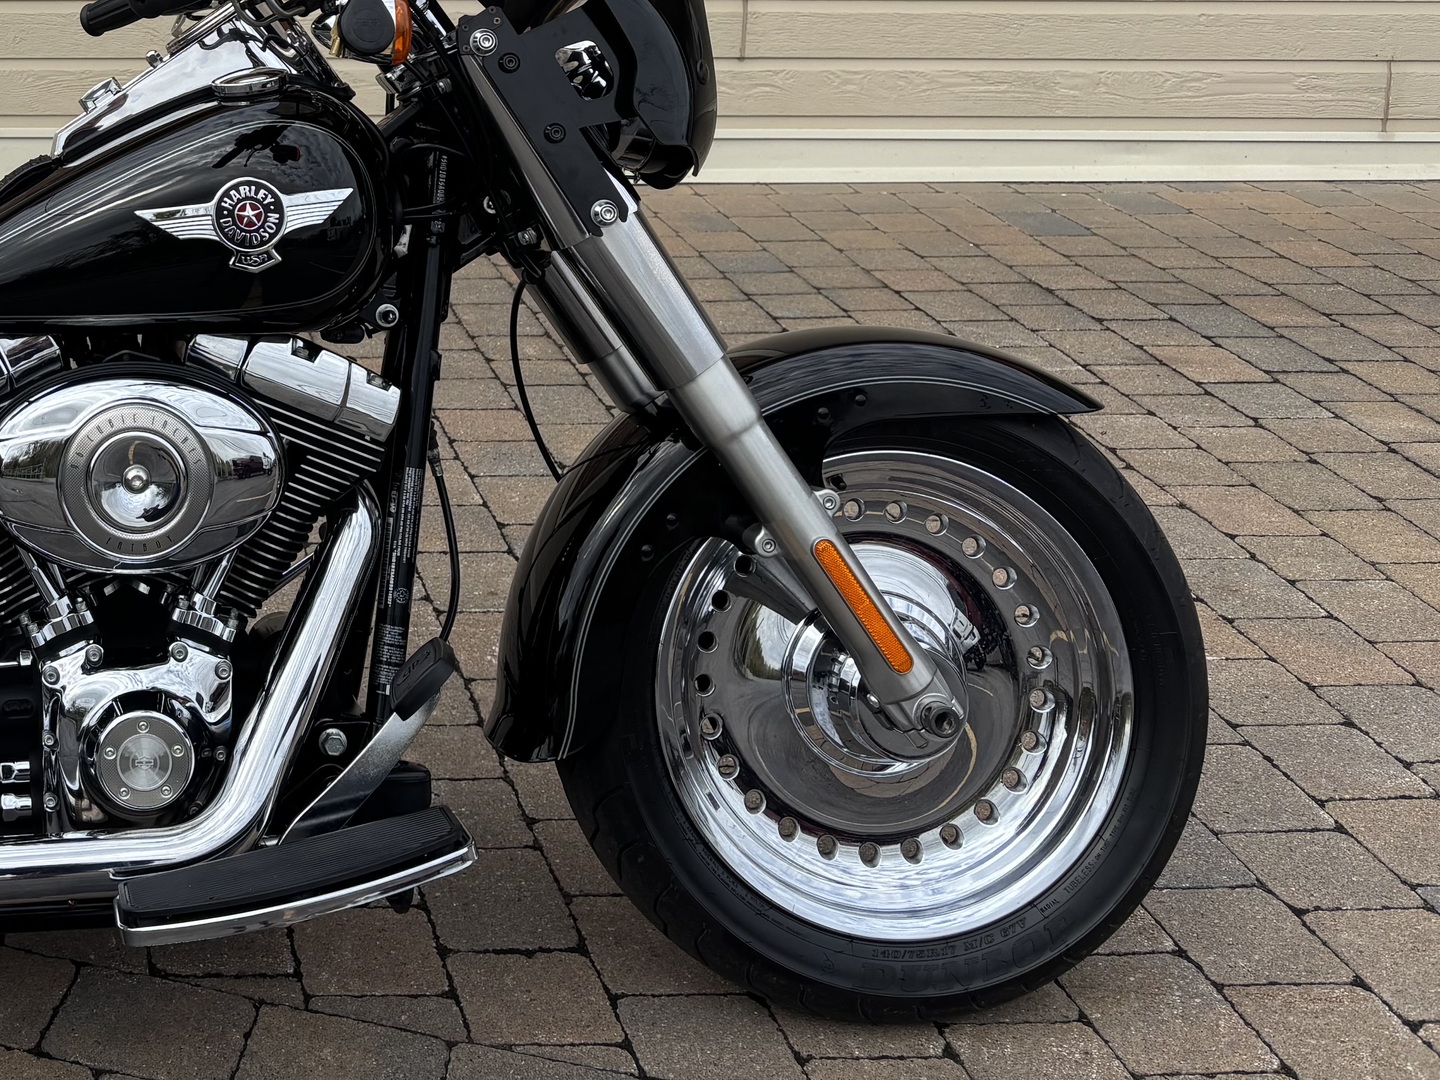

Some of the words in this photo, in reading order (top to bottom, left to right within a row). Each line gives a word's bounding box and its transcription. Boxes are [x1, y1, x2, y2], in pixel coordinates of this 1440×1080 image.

[220, 185, 275, 211] HARLEY
[219, 212, 281, 247] DAVIDSON
[241, 253, 268, 266] USA
[86, 413, 138, 443] CUBIC
[150, 416, 203, 466] INCHES
[1039, 898, 1061, 914] RADIAL
